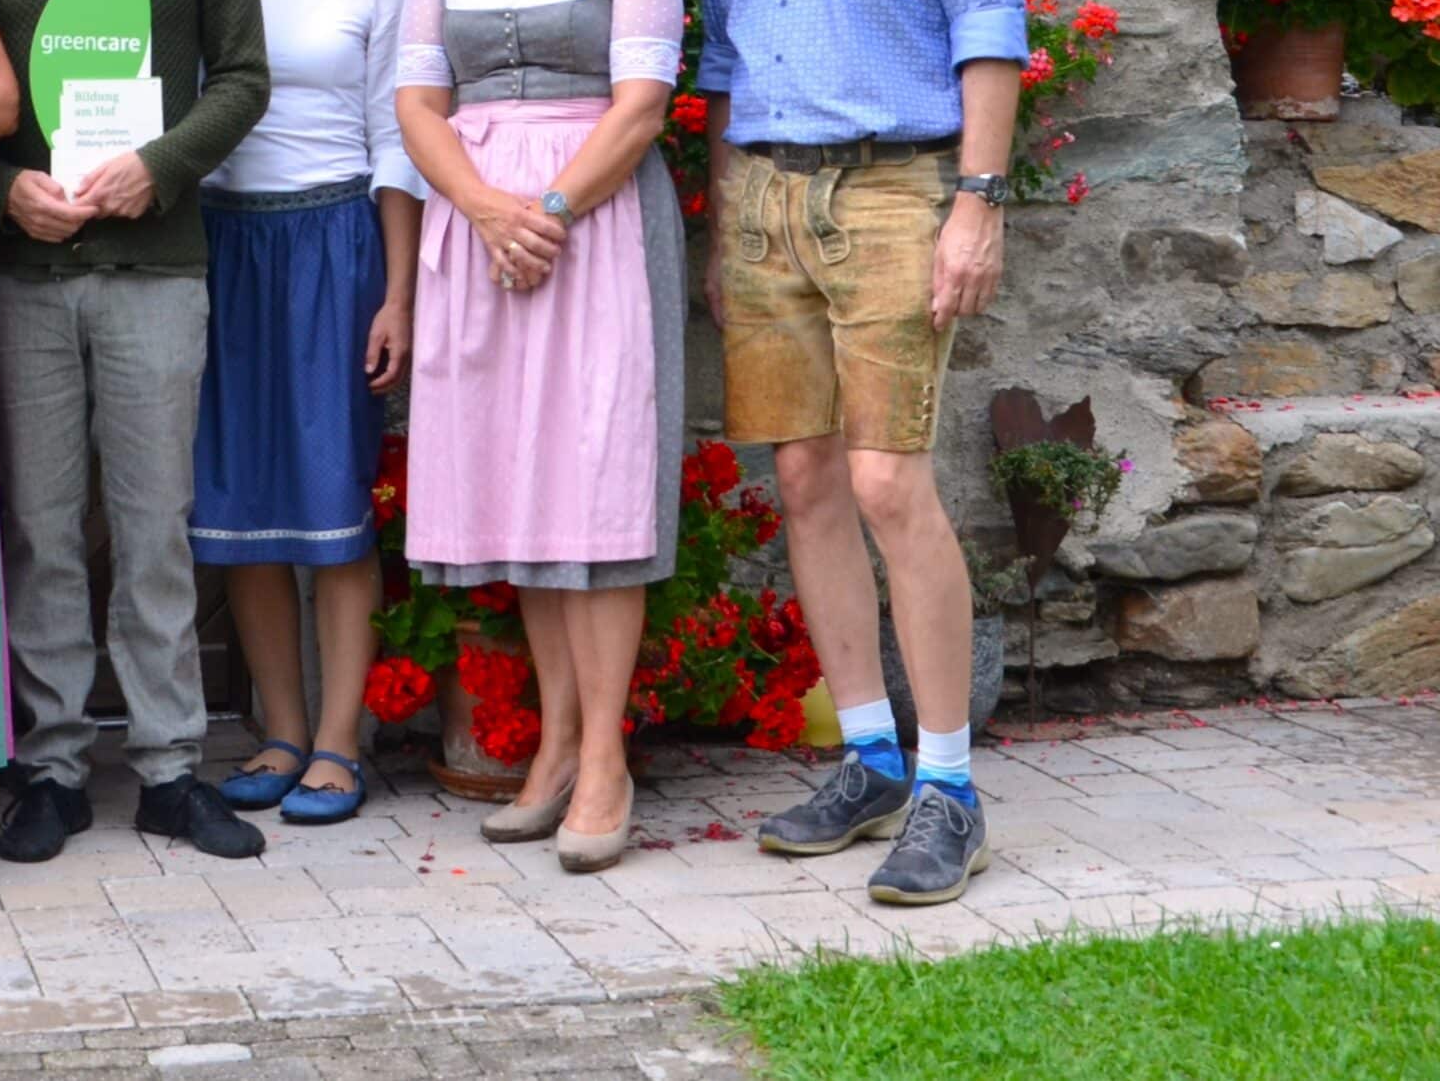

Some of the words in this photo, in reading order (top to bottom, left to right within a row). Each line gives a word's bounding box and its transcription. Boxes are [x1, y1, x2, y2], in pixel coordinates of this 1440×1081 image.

[40, 33, 141, 55] greencare
[74, 91, 120, 104] Bildung
[74, 108, 93, 117] am
[95, 106, 116, 117] Hof
